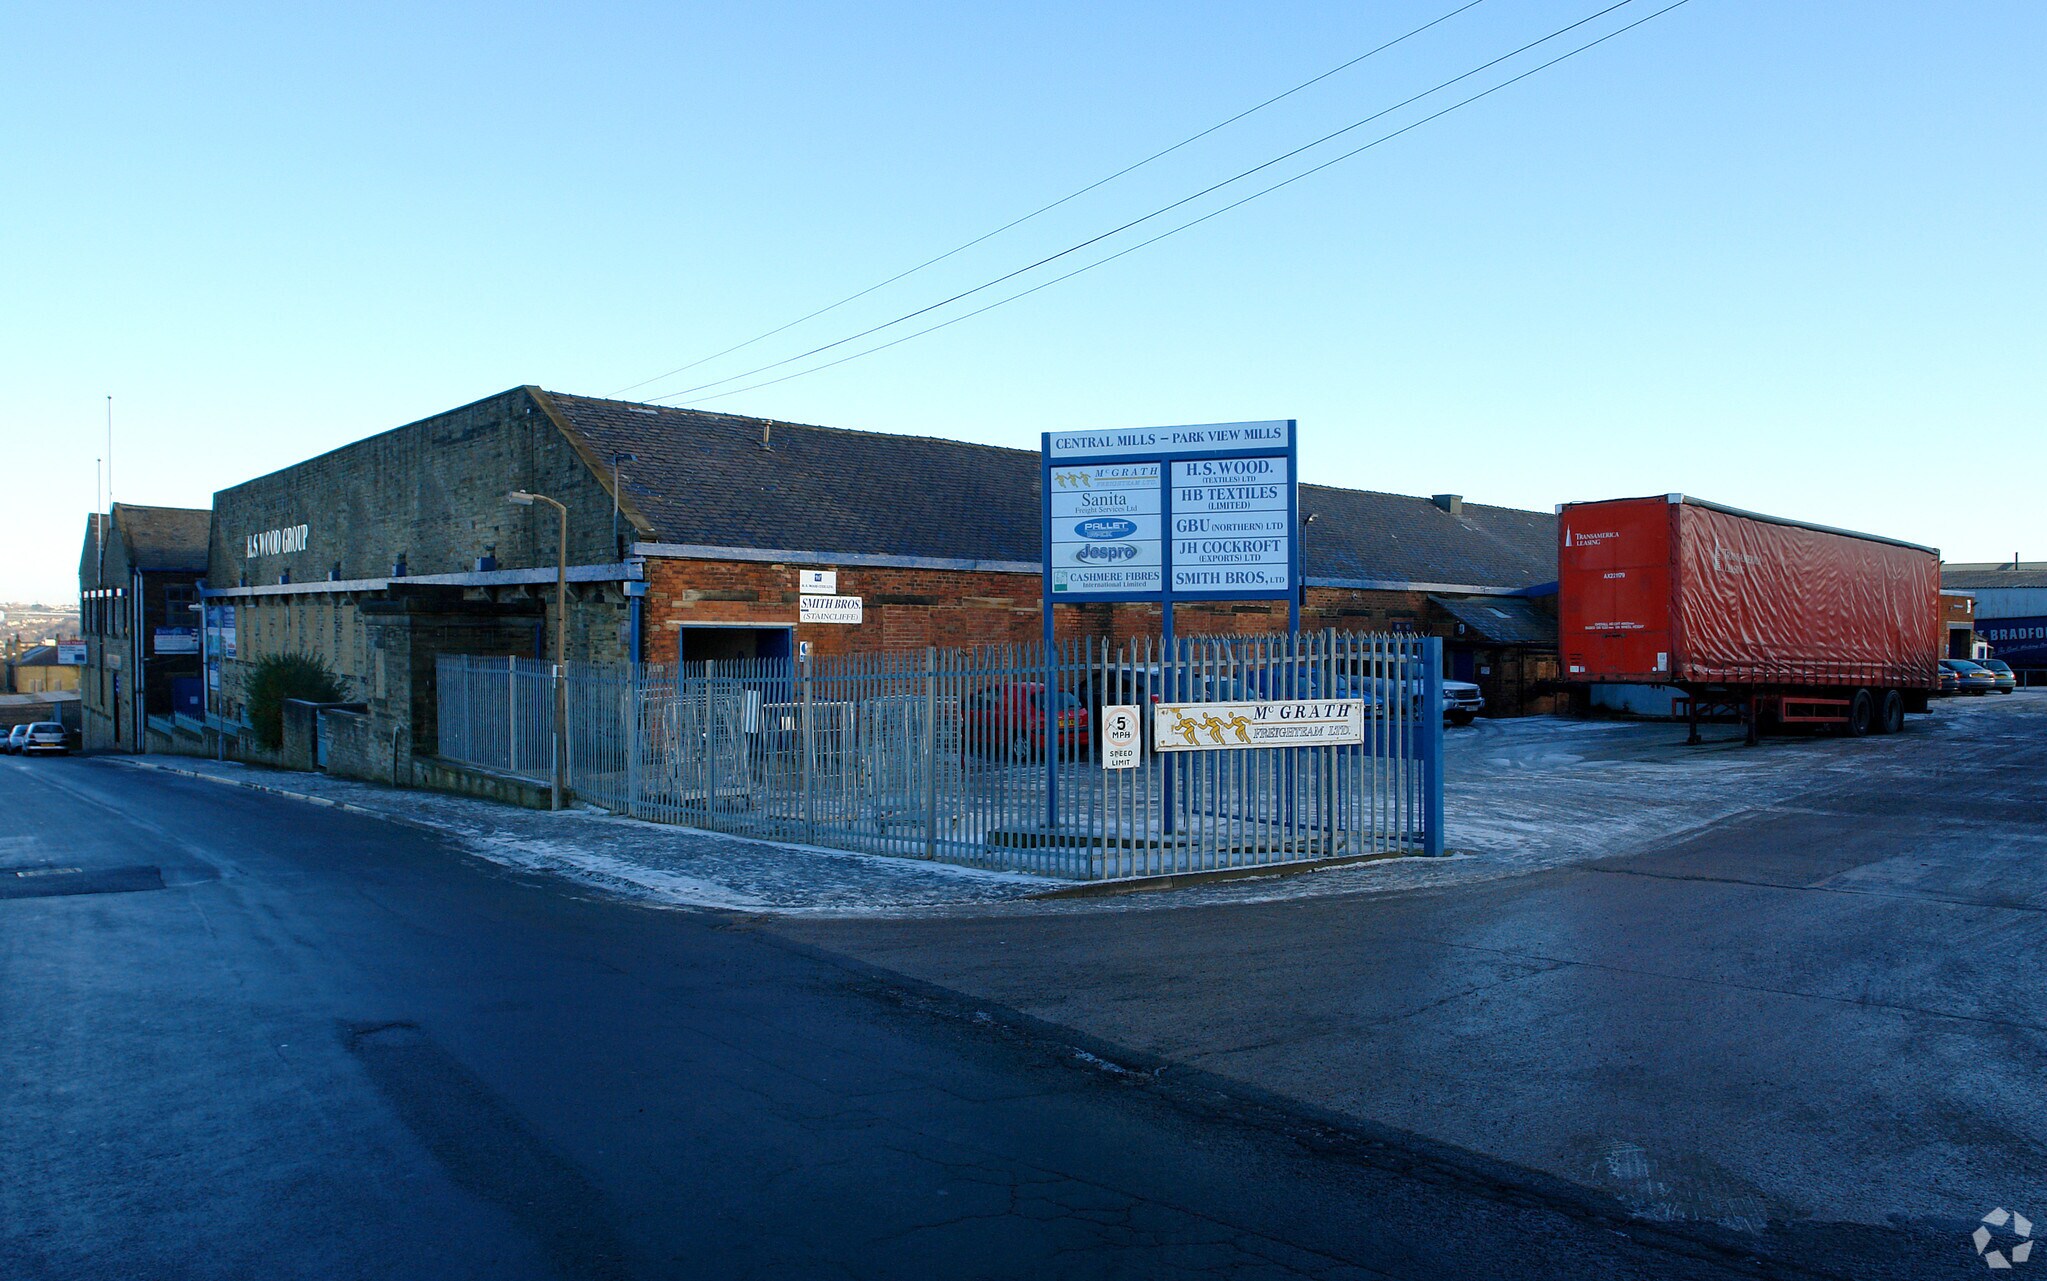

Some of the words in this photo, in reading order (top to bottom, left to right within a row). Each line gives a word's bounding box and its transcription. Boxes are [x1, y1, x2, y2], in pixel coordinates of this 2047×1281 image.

[1055, 436, 1113, 450] CENTRAL
[1117, 433, 1156, 447] MILLS
[1172, 431, 1205, 444] PARK
[1208, 429, 1241, 442] VIEW
[1244, 427, 1282, 440] MILLS
[1202, 476, 1240, 484] (TEXTILES)
[1181, 488, 1204, 501] HB
[1207, 485, 1278, 501] TEXTILES
[1081, 492, 1127, 507] Sanita
[1075, 507, 1097, 515] Freight
[1208, 501, 1251, 510] (LIMITED)
[1084, 522, 1128, 531] PALLET
[1176, 518, 1210, 533] GBU
[1211, 522, 1264, 532] (NORTHERN)
[1266, 521, 1284, 530] LTD
[282, 524, 308, 554] GROUP
[1575, 531, 1620, 541] TRANSAMERICA
[1179, 541, 1198, 555] JH
[1202, 540, 1281, 554] COCKROFT
[1576, 539, 1601, 547] LEASING
[1080, 543, 1134, 562] Jespro
[1199, 554, 1242, 563] (EXPORTS)
[1244, 554, 1261, 562] LTD
[1070, 572, 1124, 582] CASHMERE
[1125, 571, 1160, 581] FIBRES
[1175, 571, 1221, 585] SMITH
[1269, 576, 1285, 584] LTD
[1082, 581, 1121, 589] International
[800, 598, 834, 609] SMITH
[834, 599, 861, 610] BROS.
[802, 612, 859, 621] (STAINCLIFFE)
[1990, 626, 2047, 641] BRADFO
[1117, 716, 1126, 731] 5
[1112, 731, 1131, 739] MPH
[1253, 726, 1325, 739] FREIGHTEAM
[1109, 750, 1133, 758] SPEED
